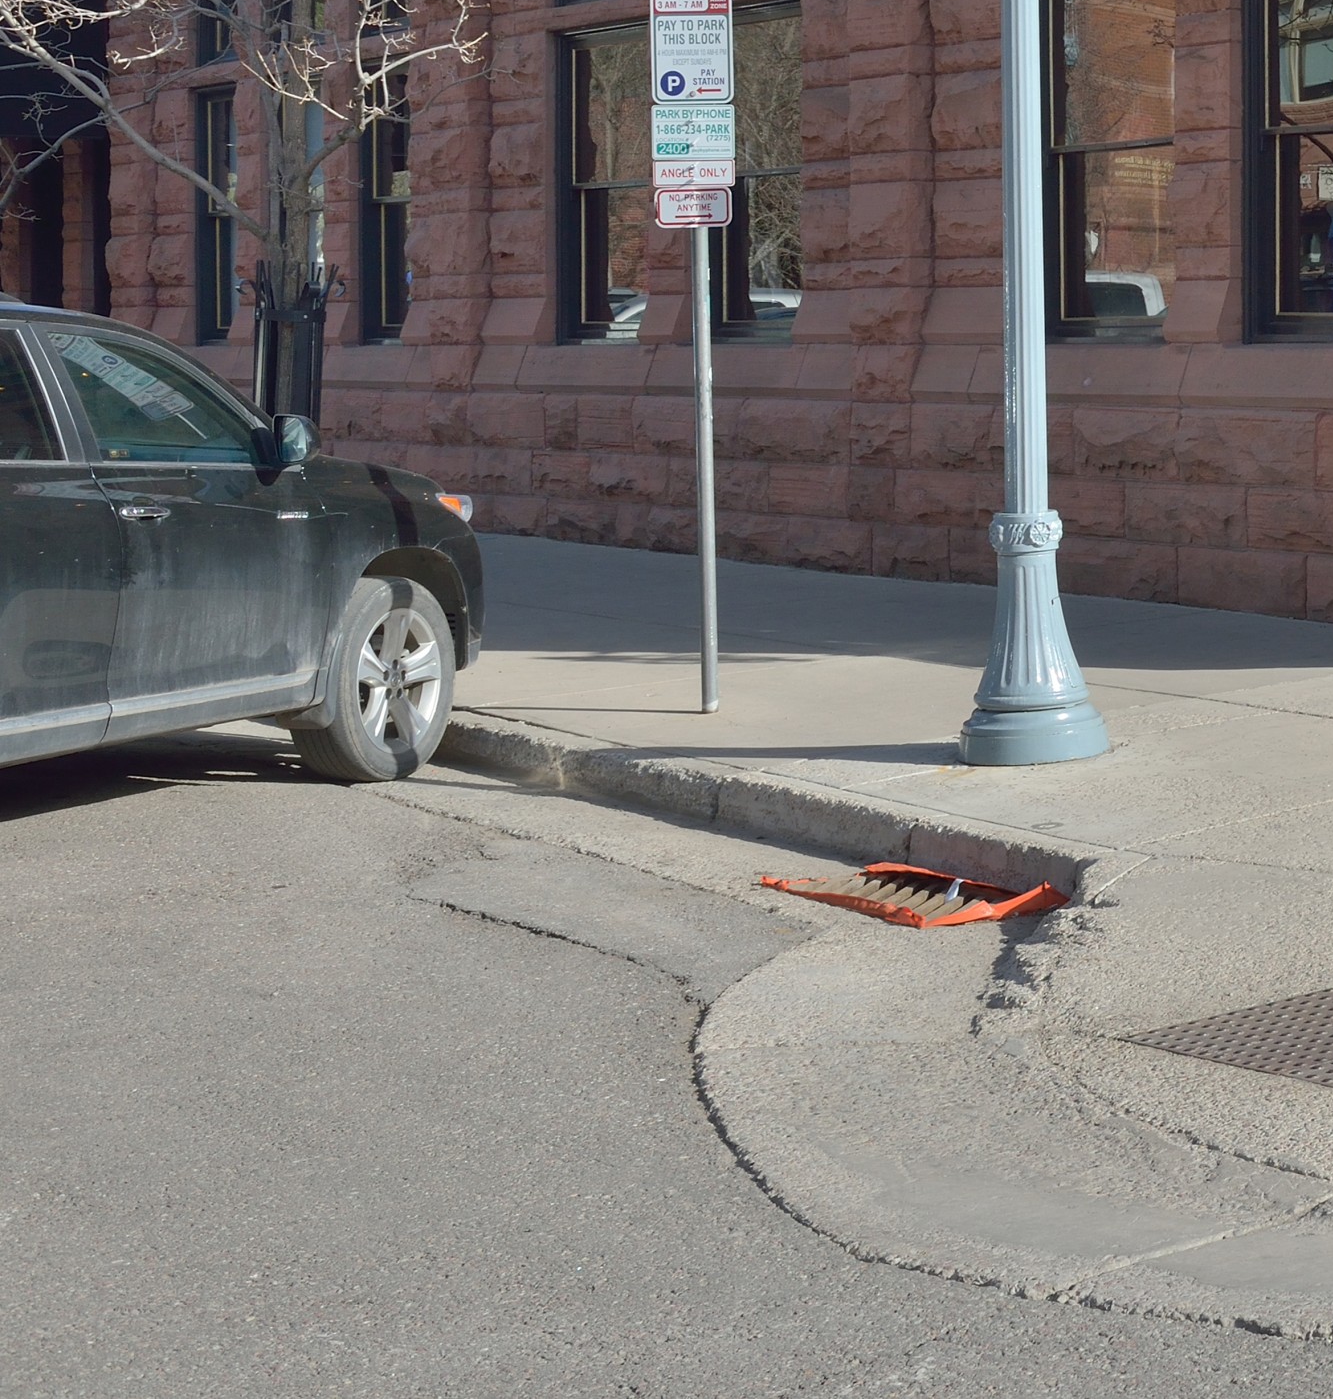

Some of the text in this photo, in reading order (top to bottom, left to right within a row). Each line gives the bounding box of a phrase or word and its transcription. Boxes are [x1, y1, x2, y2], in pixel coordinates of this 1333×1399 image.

[657, 1, 663, 9] 3
[664, 1, 677, 9] AM
[657, 19, 725, 31] PAY TO PARK
[662, 33, 722, 45] THIS BLOCK
[700, 69, 716, 77] PAY
[667, 75, 681, 92] P
[692, 77, 725, 86] STATION
[655, 109, 731, 119] PARK BY PHONE
[656, 124, 730, 135] 1-866-234-PARK
[660, 168, 728, 178] ANGLE ONLY
[668, 193, 719, 202] NO PARKING
[676, 203, 712, 211] ANYTIME
